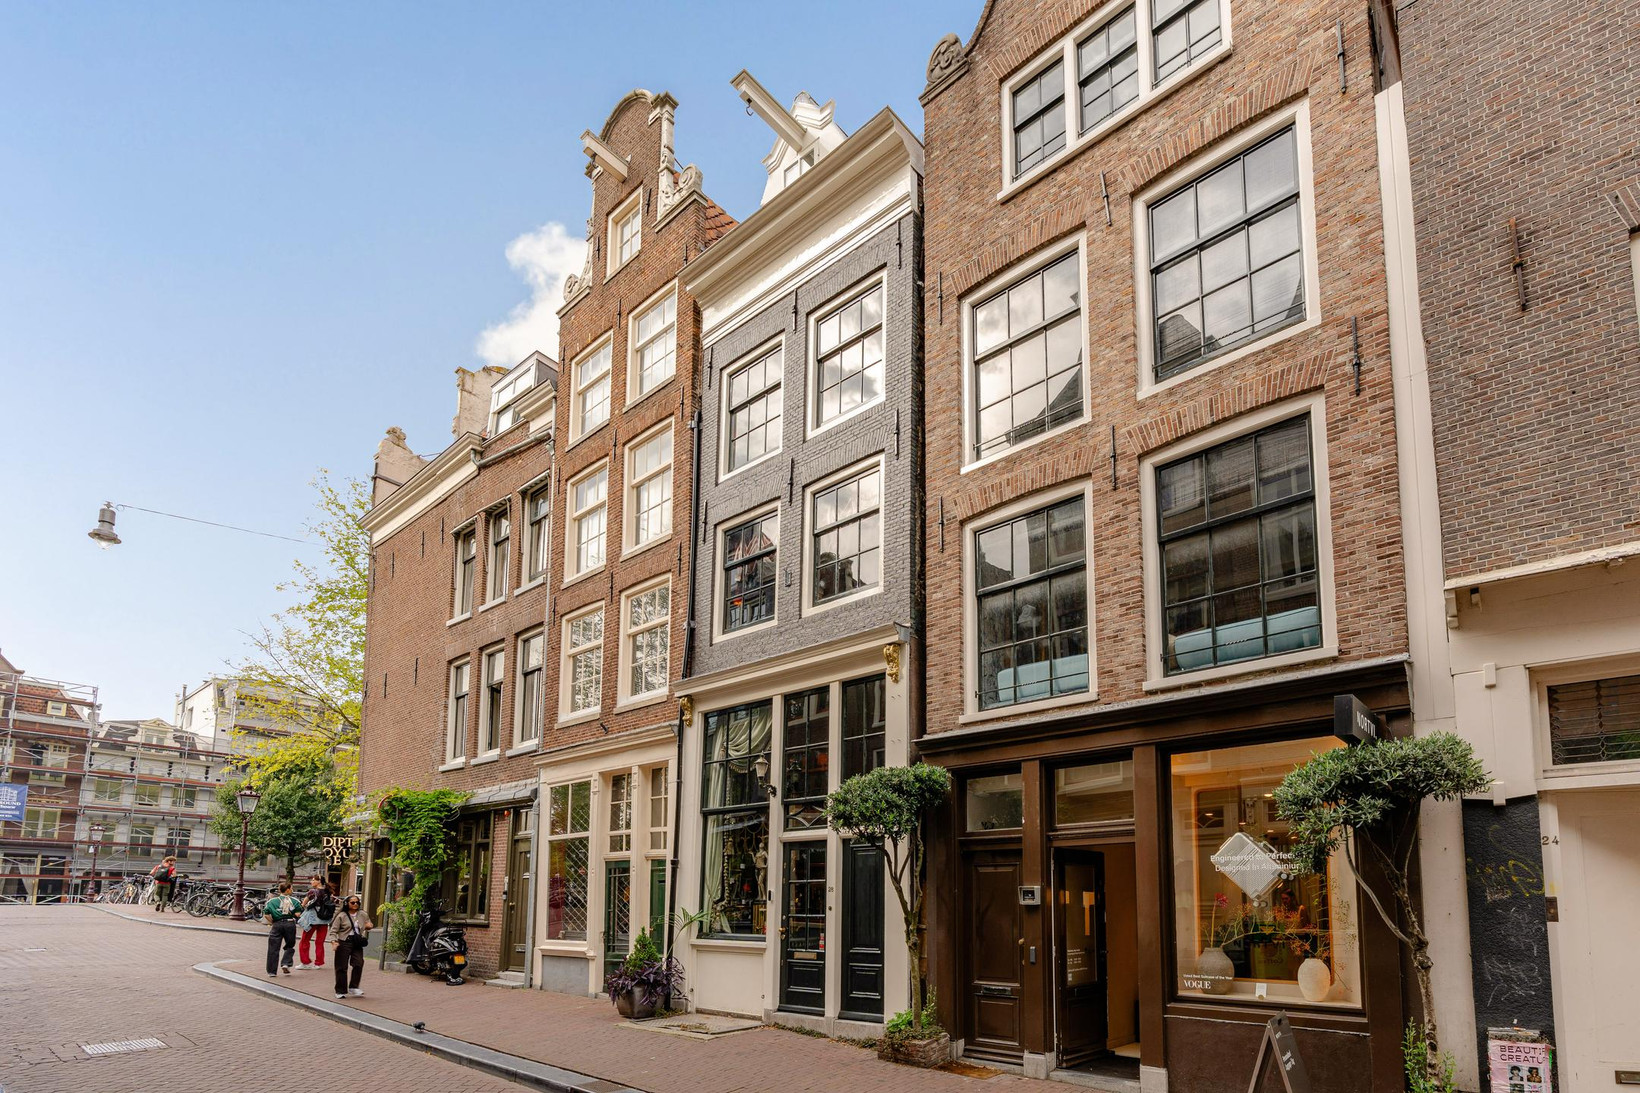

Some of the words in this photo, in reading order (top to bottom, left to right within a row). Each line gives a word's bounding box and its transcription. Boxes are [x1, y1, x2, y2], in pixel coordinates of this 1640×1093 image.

[323, 836, 352, 847] DIPT
[1541, 835, 1559, 845] 24
[332, 856, 342, 865] E
[1183, 979, 1211, 989] VOGUE
